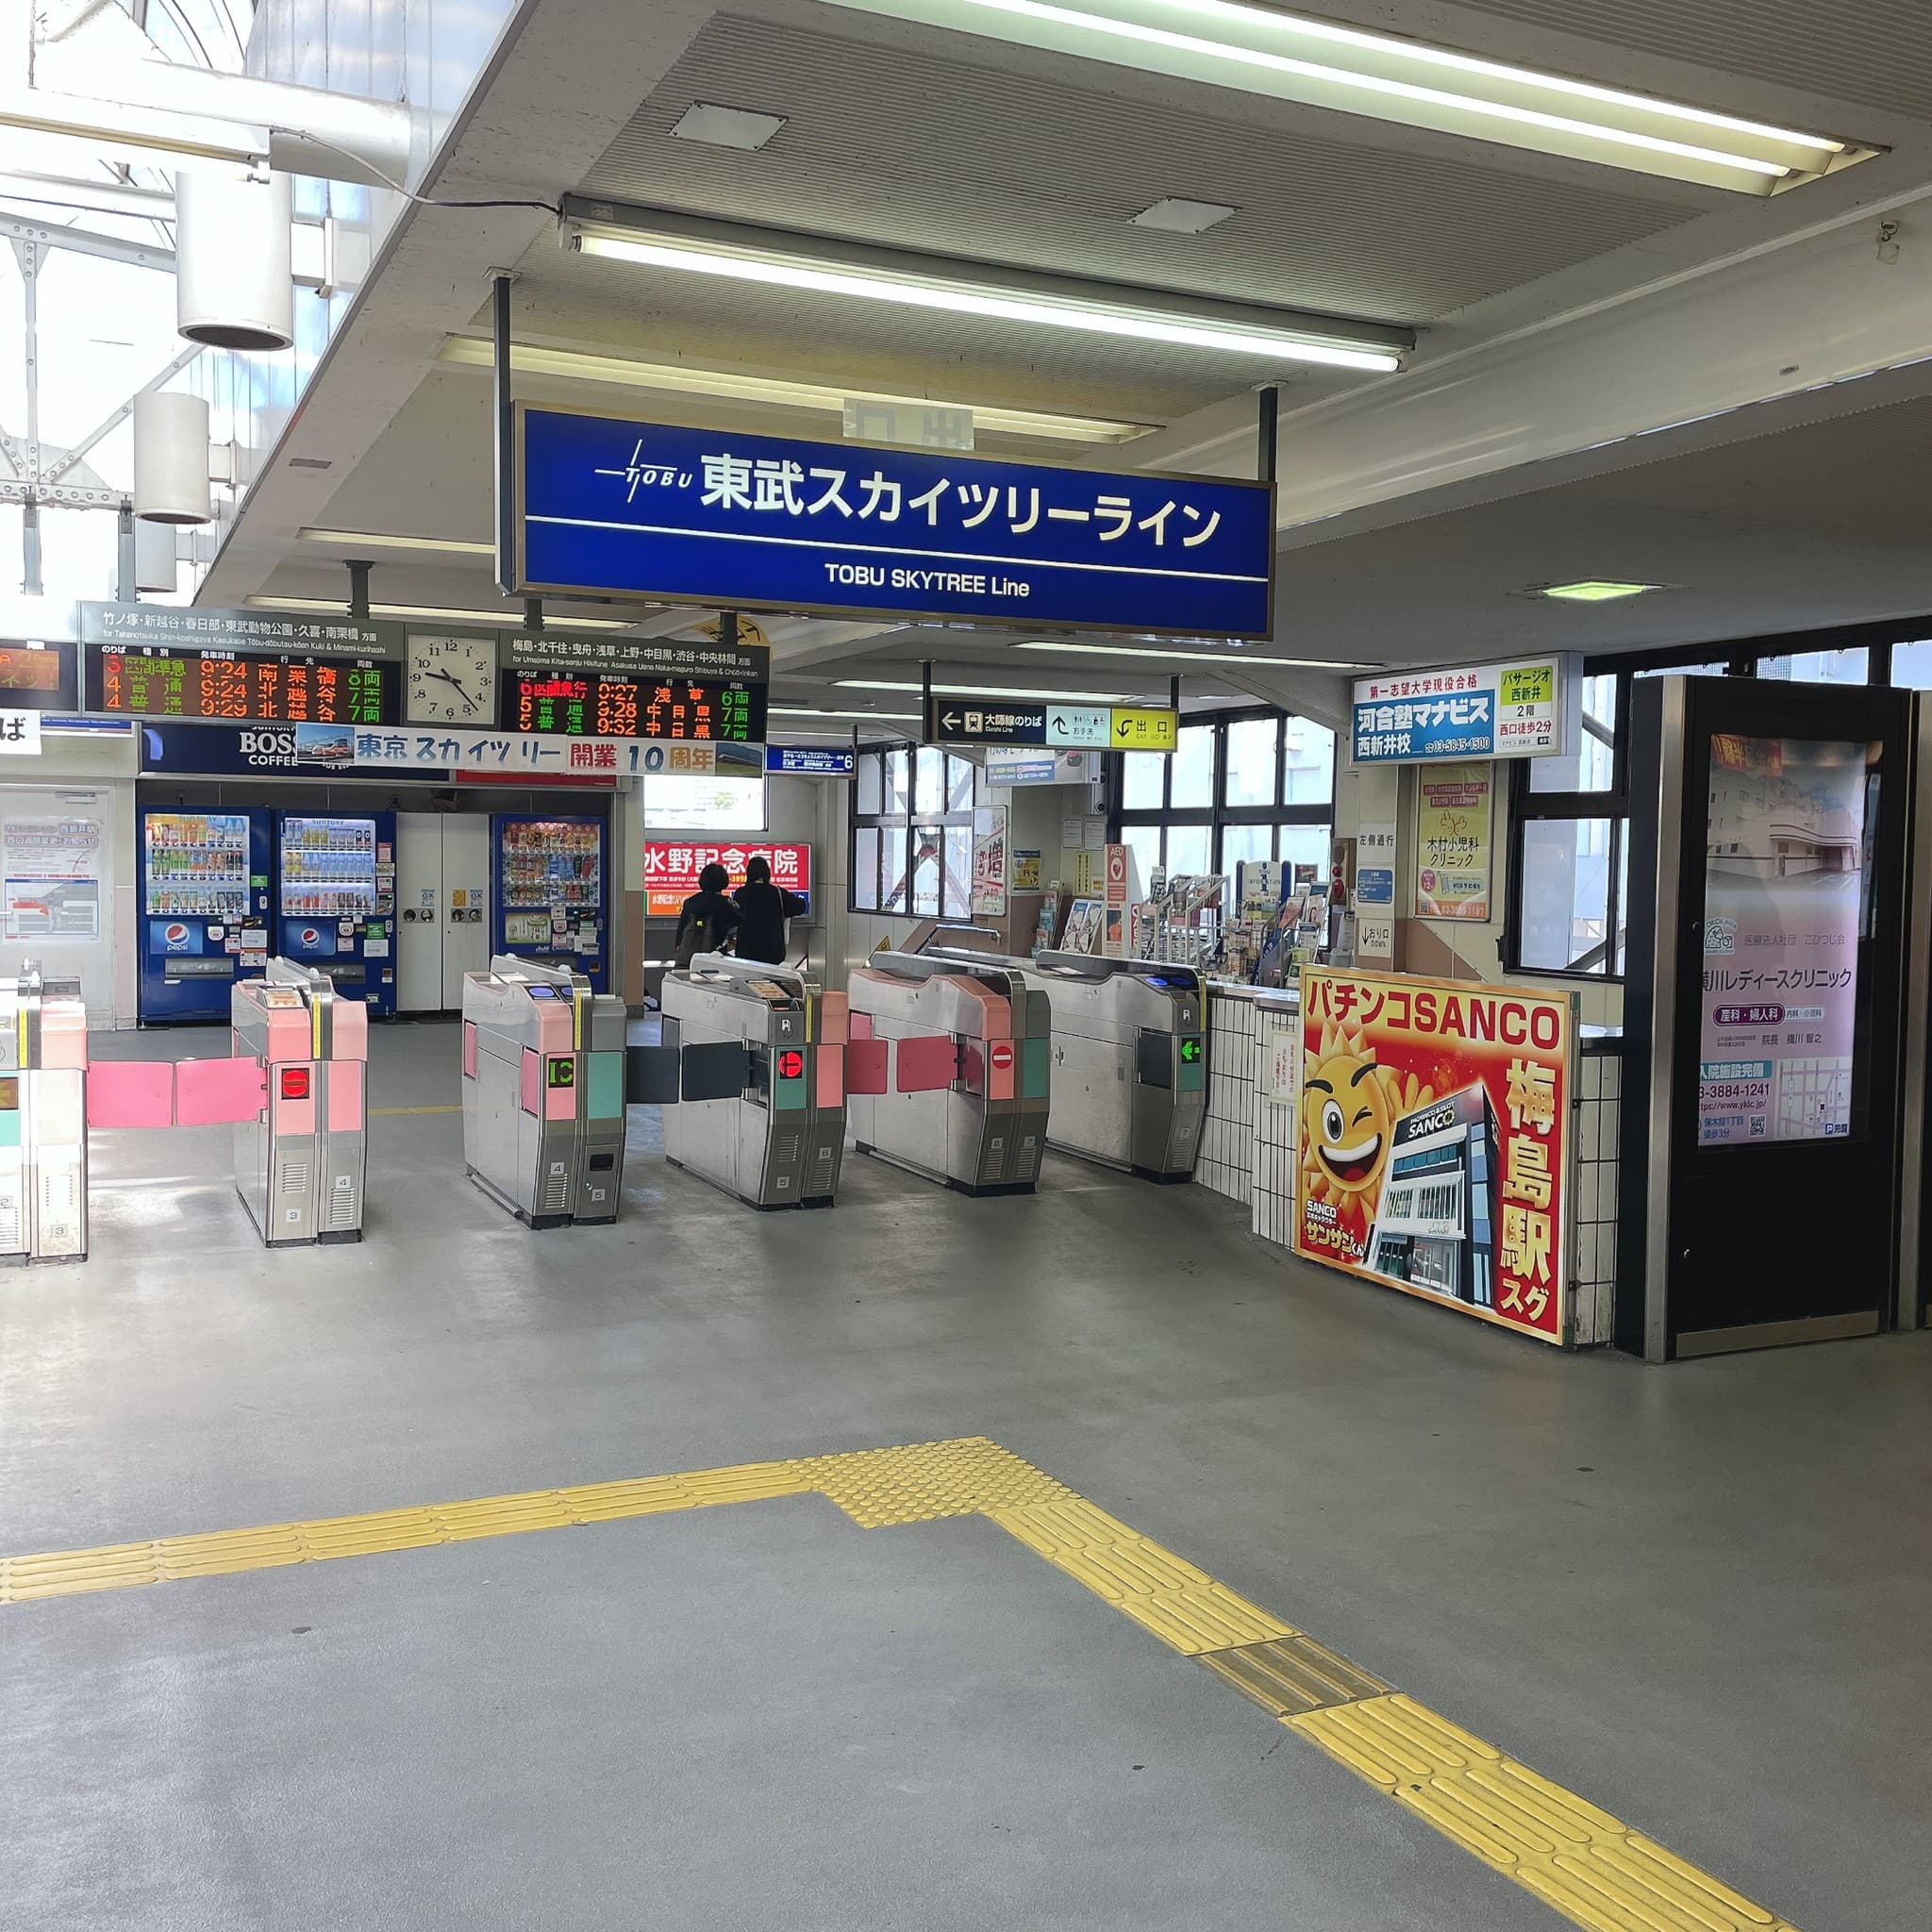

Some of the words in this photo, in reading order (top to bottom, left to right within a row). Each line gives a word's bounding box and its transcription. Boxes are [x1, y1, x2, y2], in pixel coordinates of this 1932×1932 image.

[625, 467, 692, 488] TOBU
[700, 453, 1221, 548] 東武スカイツリーライン
[824, 562, 886, 587] TOBU
[891, 568, 986, 595] SKYTREE
[991, 575, 1031, 599] Line
[101, 645, 127, 654] のりば
[429, 647, 440, 656] 11
[445, 642, 458, 651] 12
[418, 659, 430, 668] 10
[475, 661, 484, 670] 2
[412, 674, 421, 682] 9
[480, 677, 489, 686] 3
[517, 670, 538, 678] のりば
[107, 675, 121, 692] 4
[1370, 674, 1478, 700] 第一志望大学現役合格
[107, 693, 121, 708] 4
[417, 690, 426, 698] 8
[475, 692, 483, 701] 4
[722, 691, 749, 707] 6両
[1511, 686, 1541, 701] 西新井
[429, 703, 438, 711] 7
[445, 708, 455, 716] 6
[462, 705, 471, 713] 5
[520, 696, 532, 712] 5
[722, 708, 748, 723] 7両
[1357, 696, 1490, 733] 河合塾マナビス
[1517, 705, 1535, 717] 2階
[985, 713, 1042, 726] 大師線のりば
[1137, 720, 1167, 732] 出口
[0, 717, 25, 741] ば
[1499, 721, 1552, 736] 西口徒歩2分
[239, 732, 296, 754] BOS
[1357, 733, 1410, 757] 西新井校
[844, 755, 854, 769] 6
[1359, 834, 1394, 847] 左側通行
[1426, 837, 1479, 852] 木村小児科
[1110, 846, 1124, 856] AED
[1431, 853, 1474, 867] クリニック
[1307, 979, 1560, 1050] パチンコSANCO
[1720, 1008, 1778, 1023] 産科・婦人科
[1408, 1109, 1456, 1138] SANCO
[1500, 1058, 1556, 1282] 梅島駅
[1307, 1200, 1337, 1218] SANCO
[1307, 1221, 1364, 1257] サンサンくん
[1500, 1278, 1550, 1321] スグ
